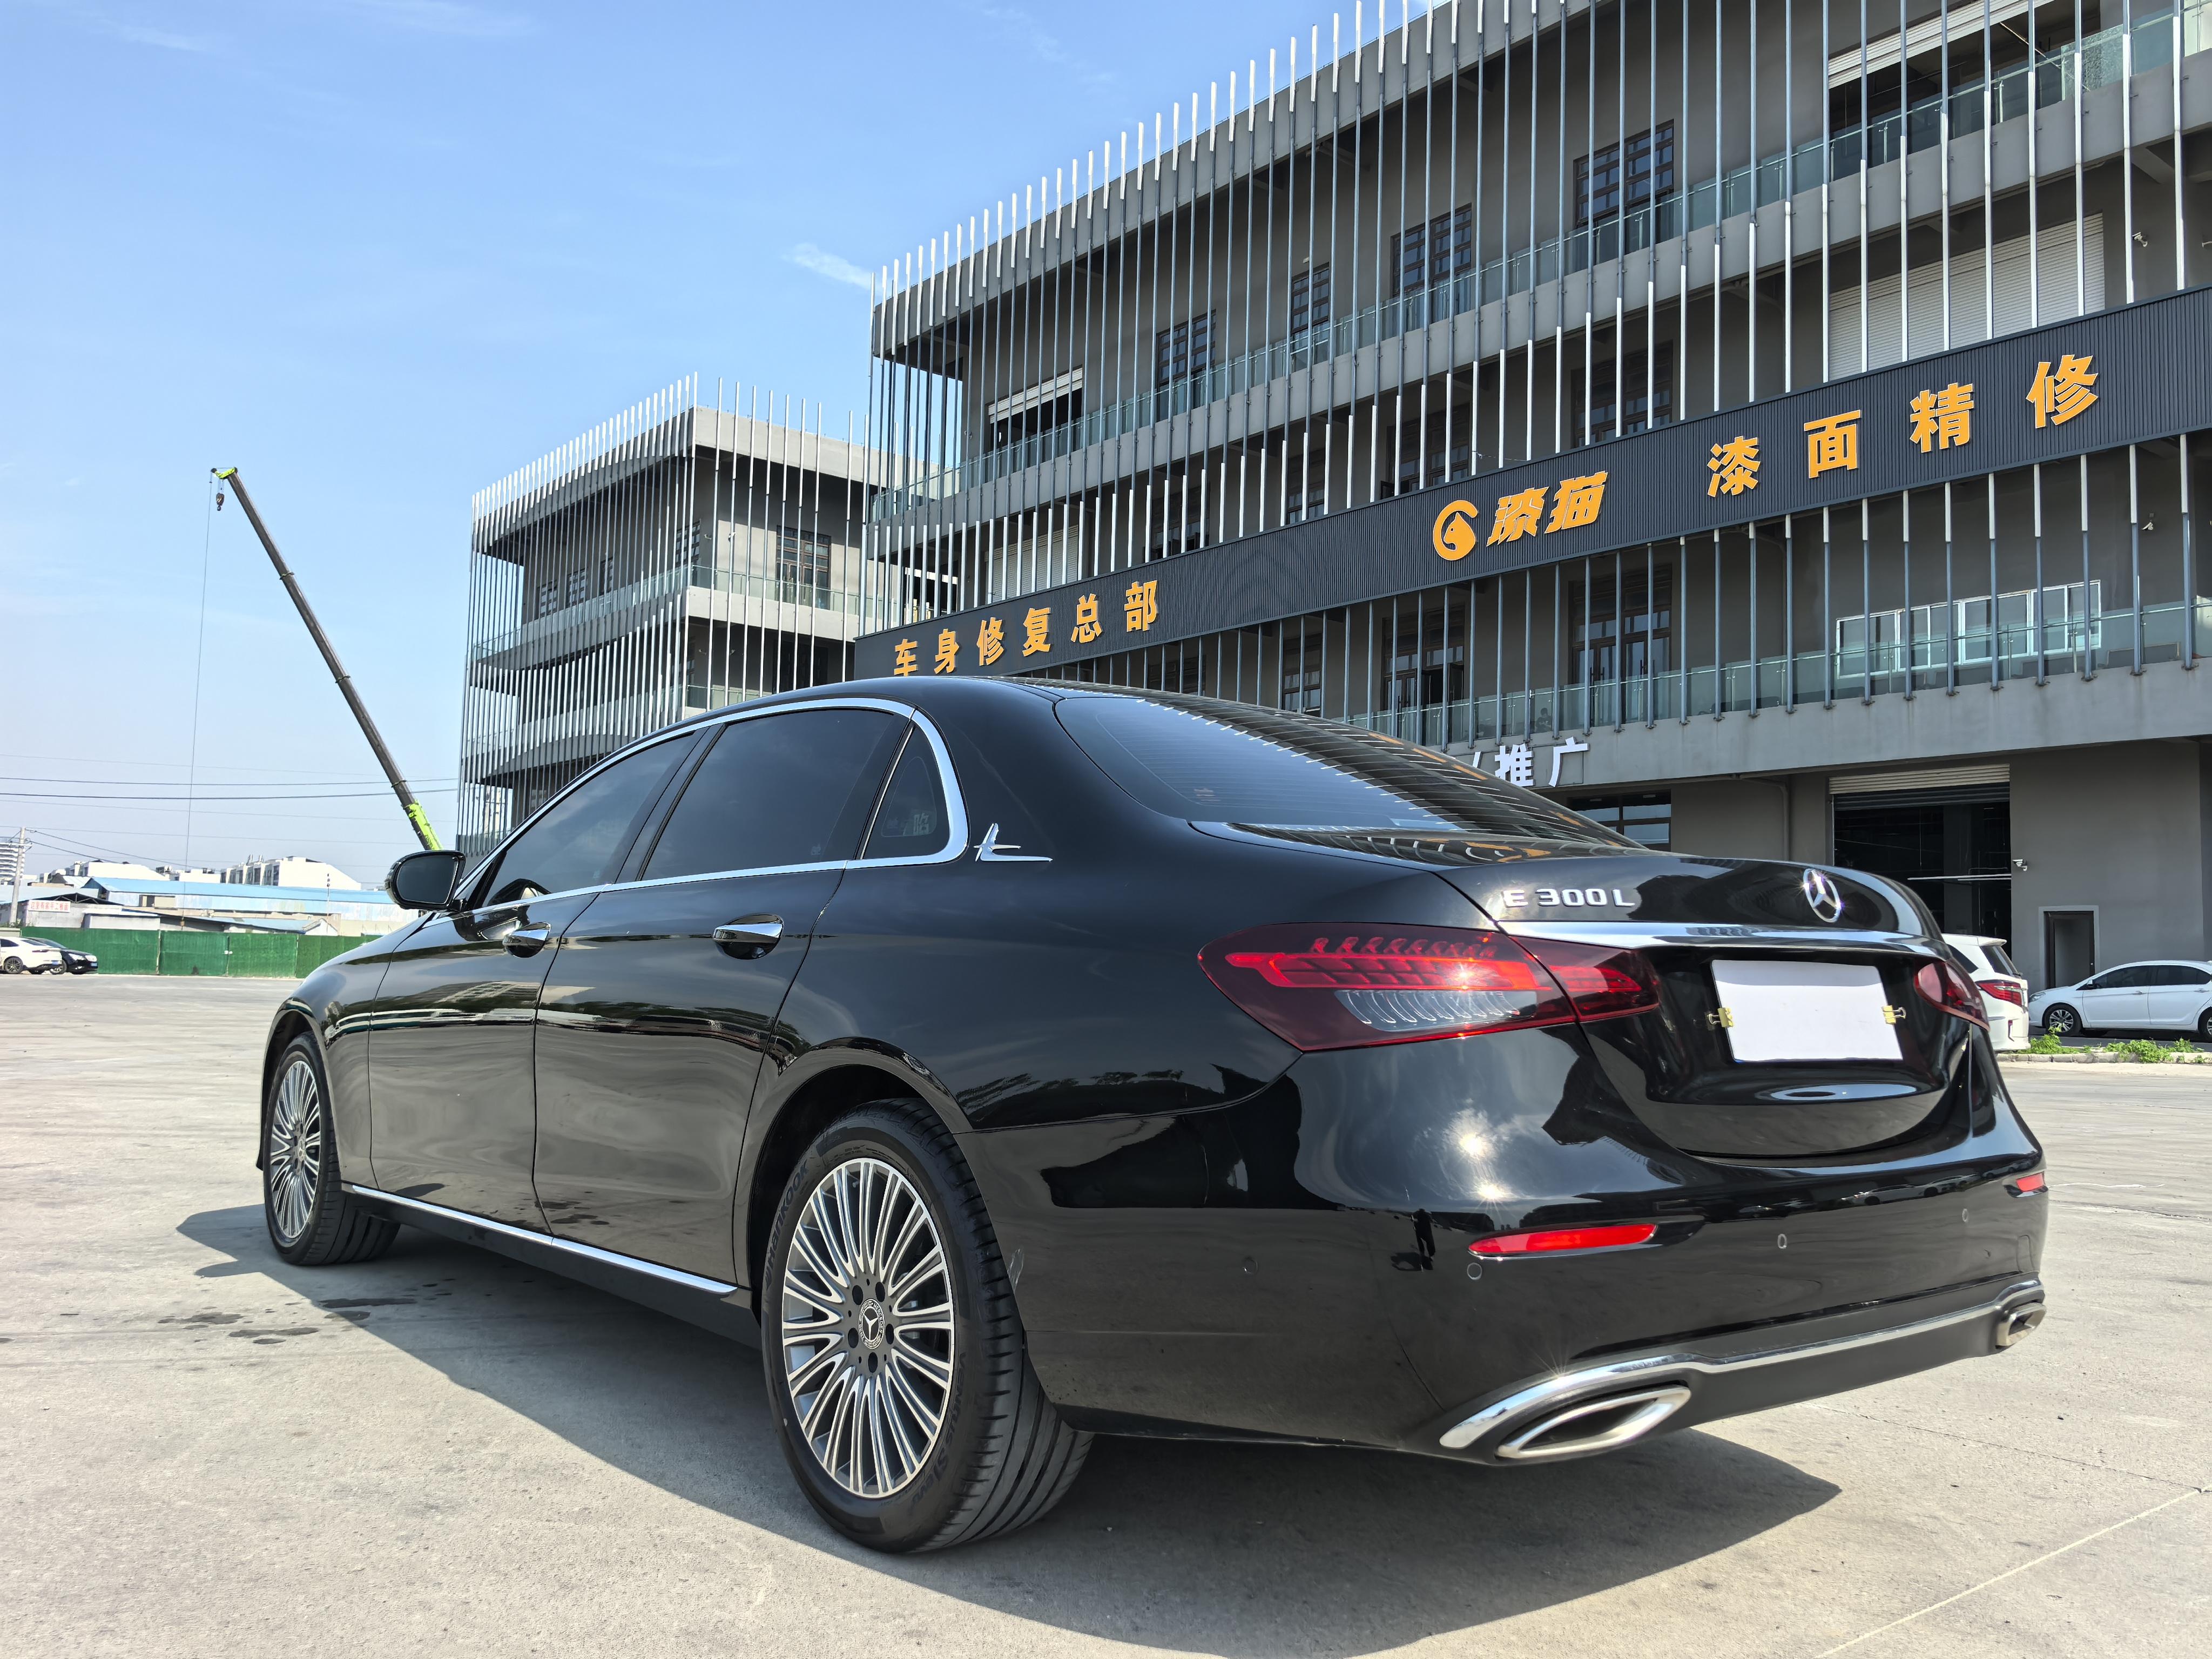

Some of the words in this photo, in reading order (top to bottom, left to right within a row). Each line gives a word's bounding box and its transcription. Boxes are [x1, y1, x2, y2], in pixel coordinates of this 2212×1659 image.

[1707, 354, 2099, 497] 漆面精修
[894, 580, 1158, 676] 车身修复总部
[1472, 736, 1590, 787] 推广
[1503, 889, 1528, 907] E
